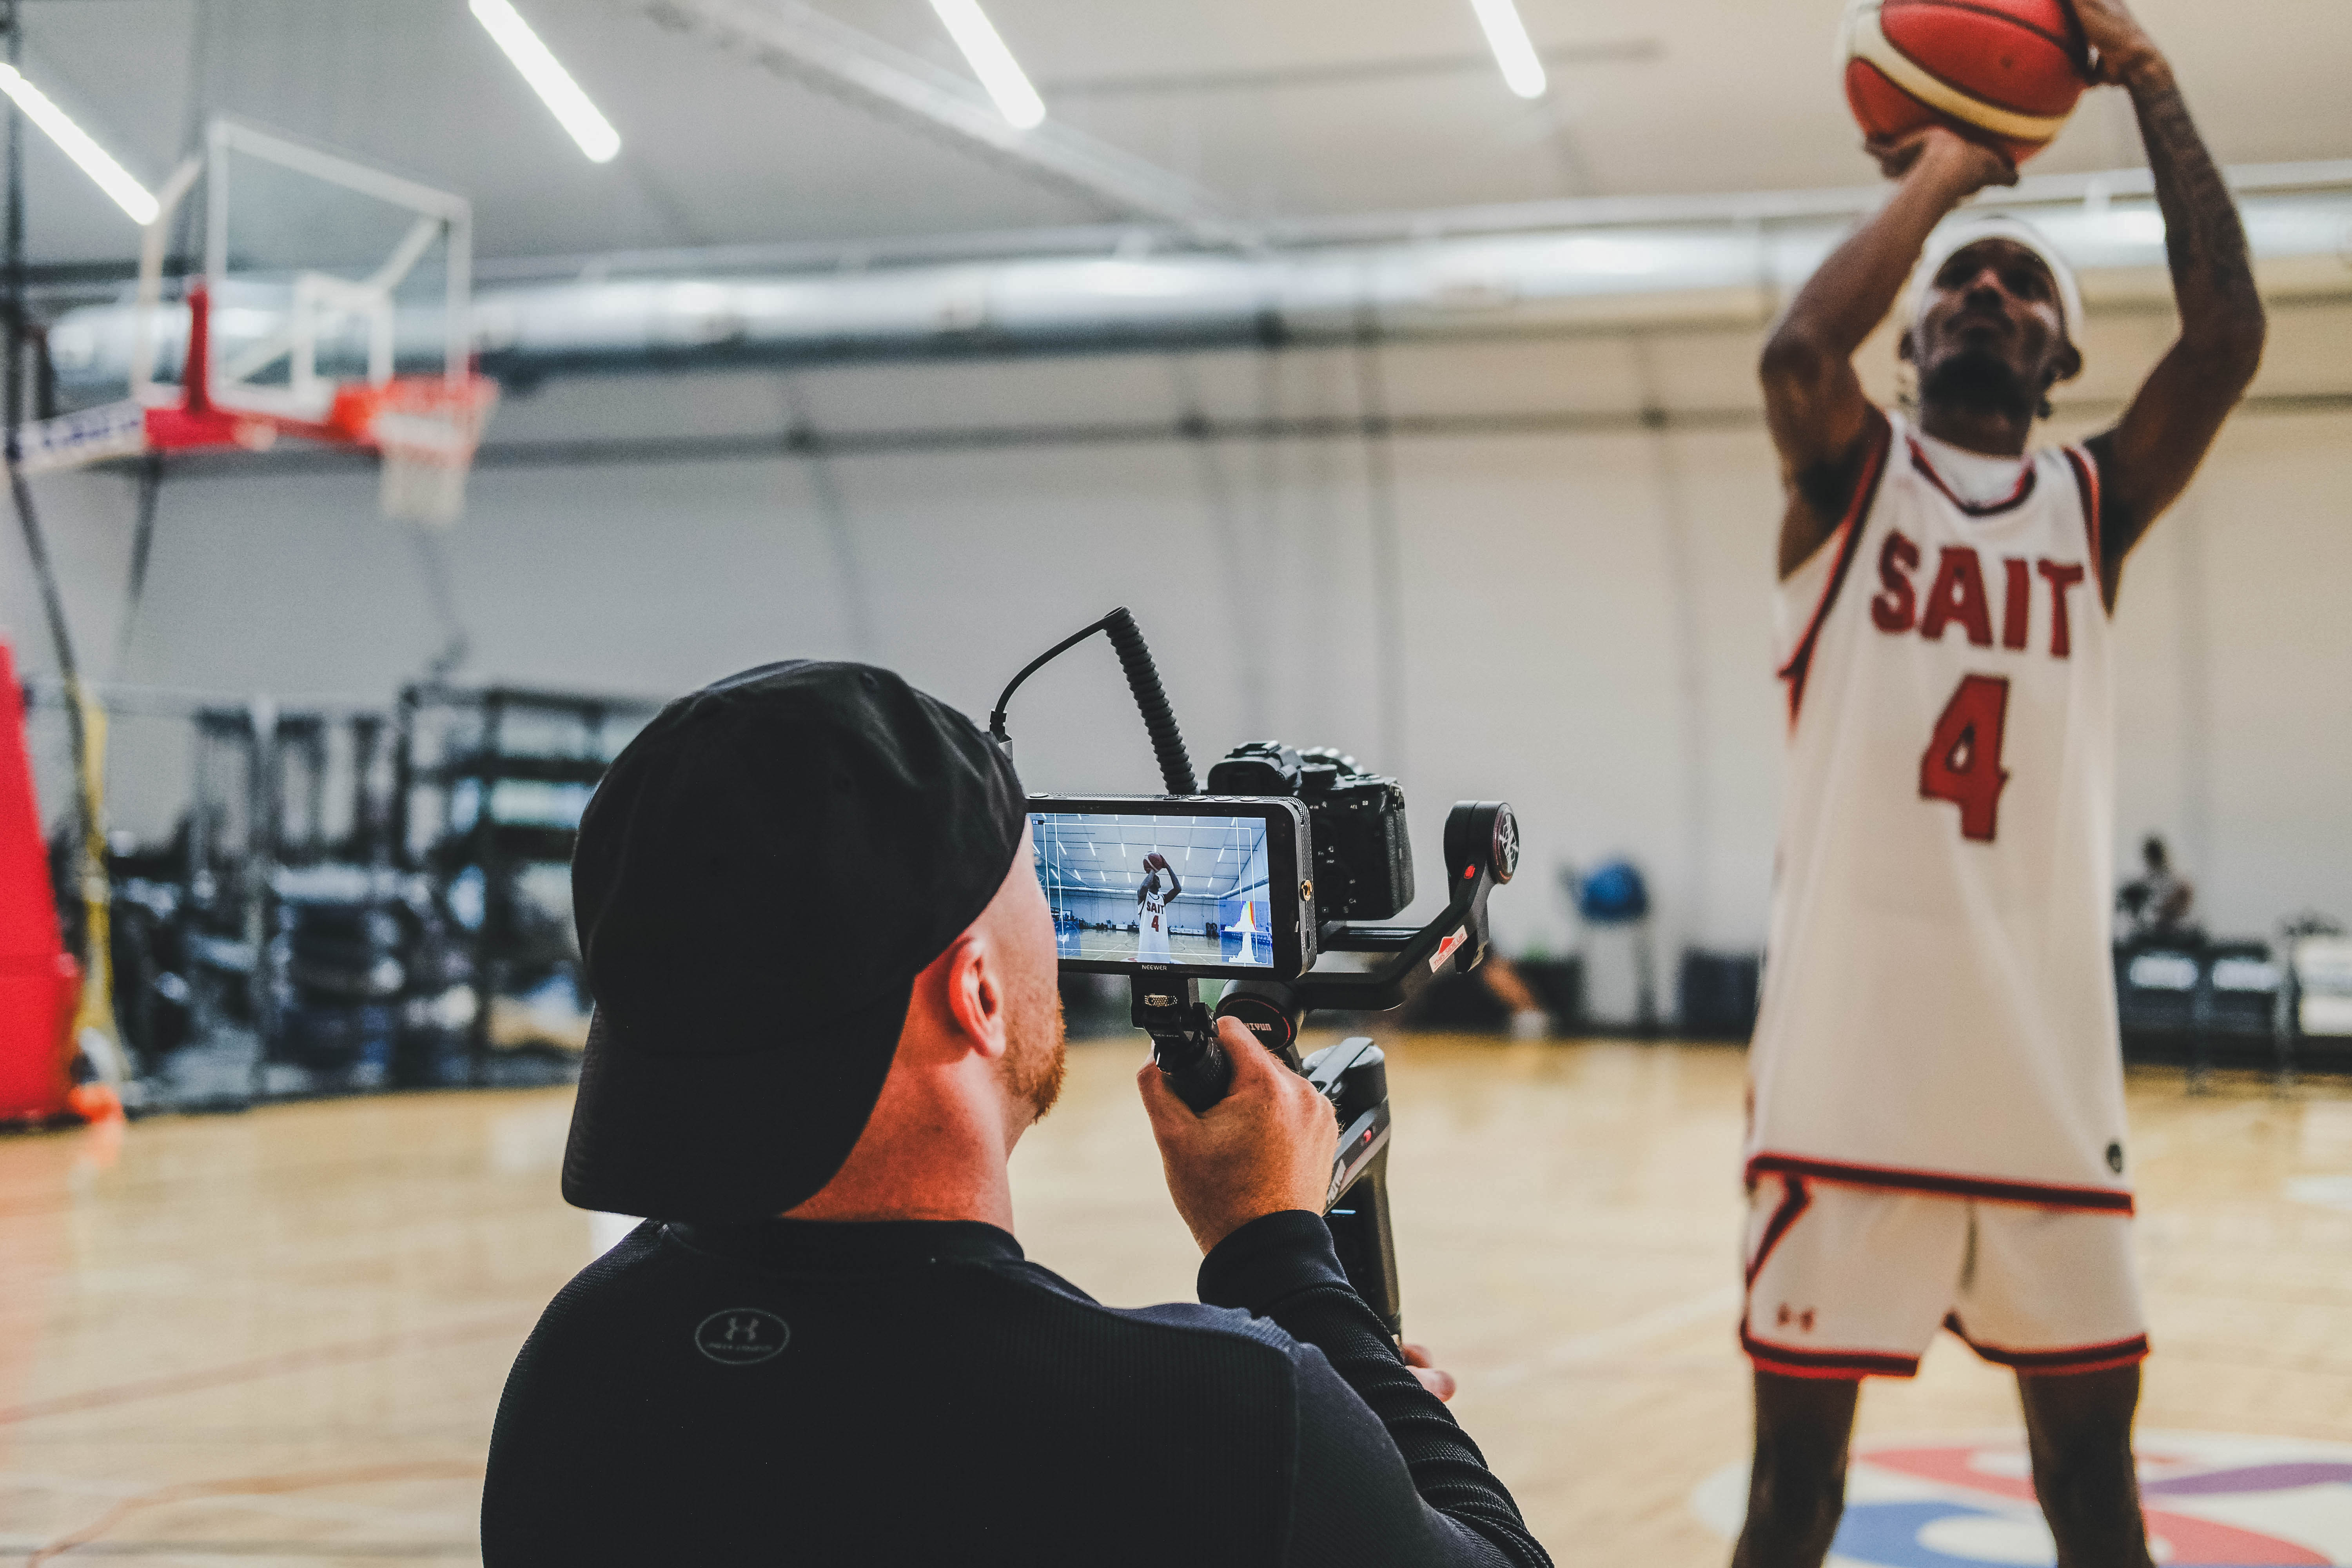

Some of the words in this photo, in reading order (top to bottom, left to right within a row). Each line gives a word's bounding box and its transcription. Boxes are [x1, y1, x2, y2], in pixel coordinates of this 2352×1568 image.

[1871, 529, 2083, 659] SAIT
[1919, 674, 2009, 841] 4
[1147, 901, 1164, 914] SAIT
[1151, 915, 1159, 932] 4
[1434, 954, 1445, 965] THIS
[1445, 942, 1457, 953] SIDE
[1456, 933, 1463, 942] UP
